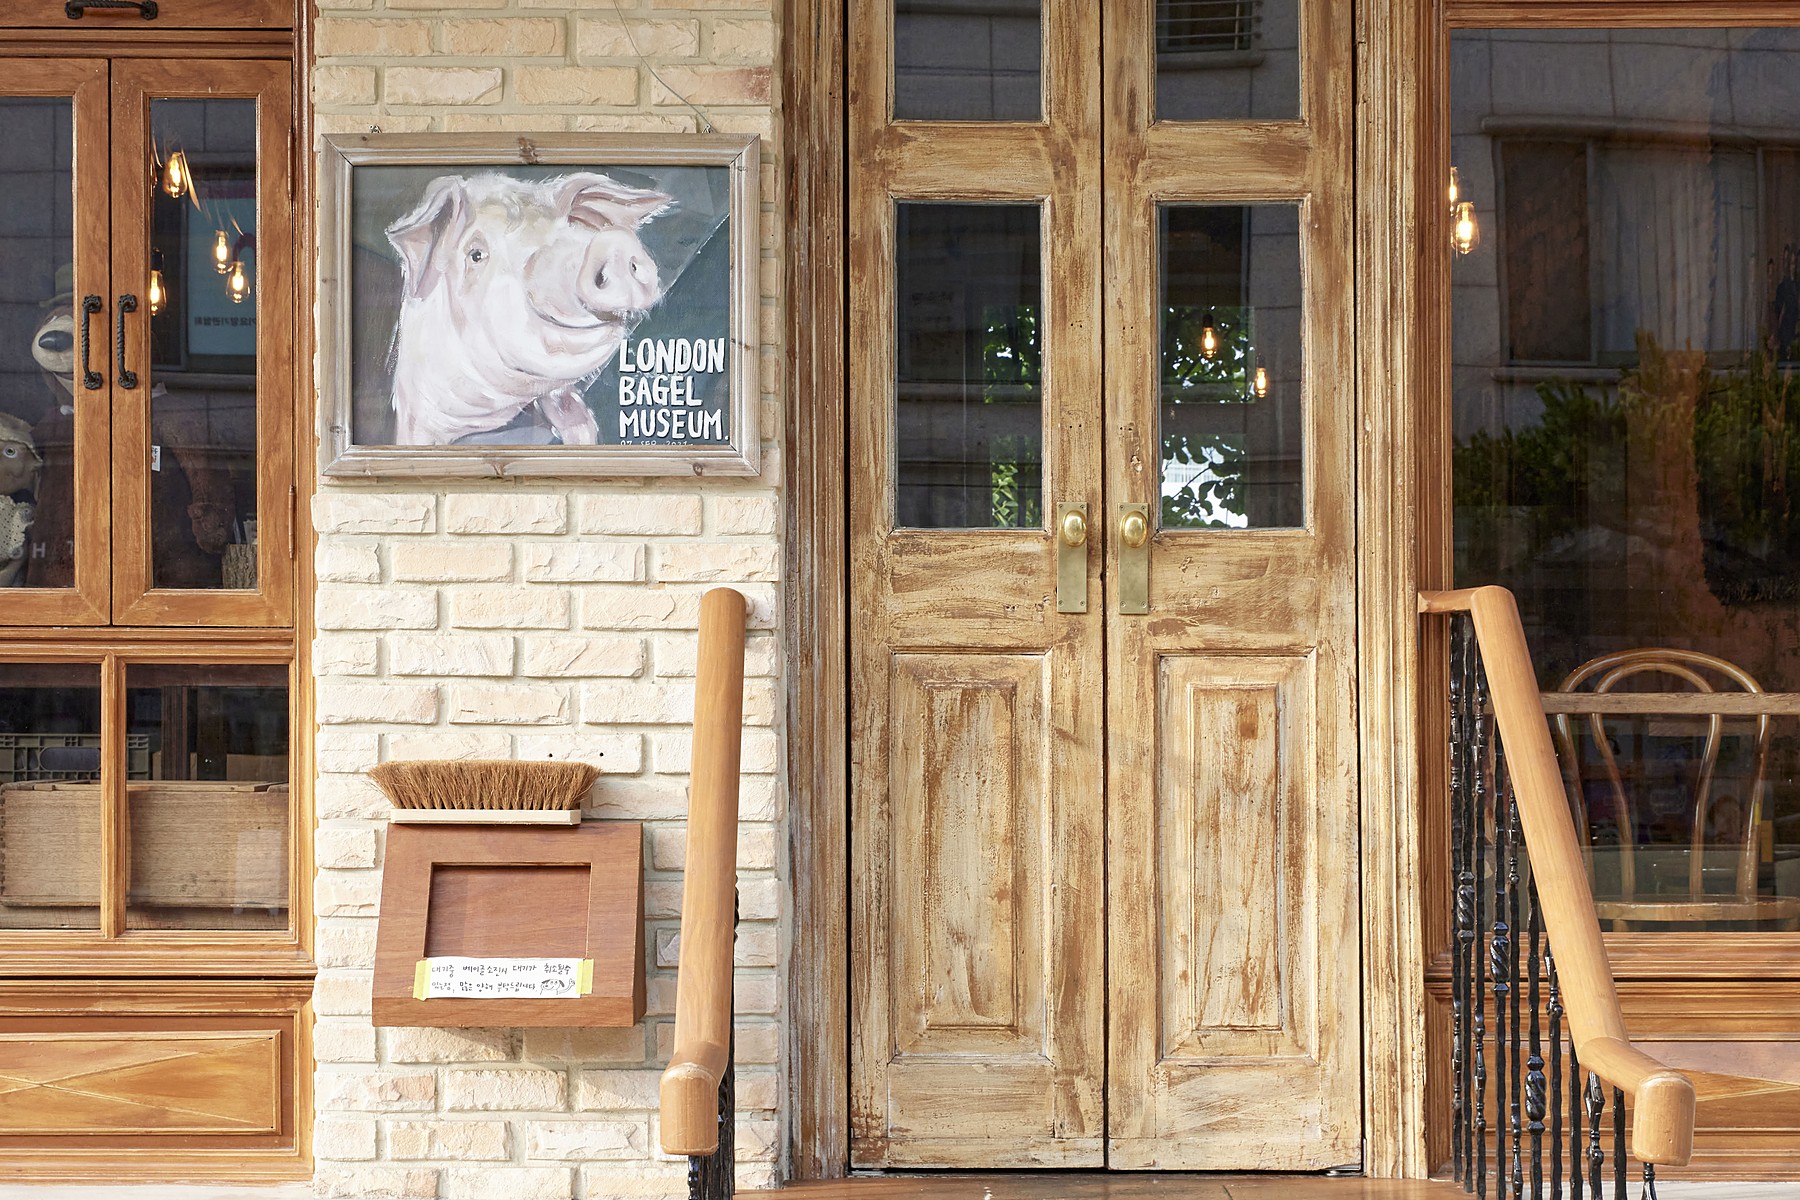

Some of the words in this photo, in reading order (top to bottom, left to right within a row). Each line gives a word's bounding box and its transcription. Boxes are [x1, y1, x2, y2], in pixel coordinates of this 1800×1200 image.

[619, 338, 725, 373] LONDON
[619, 375, 703, 406] BAGEL
[431, 964, 454, 978] 대기중
[512, 965, 537, 973] 대기가
